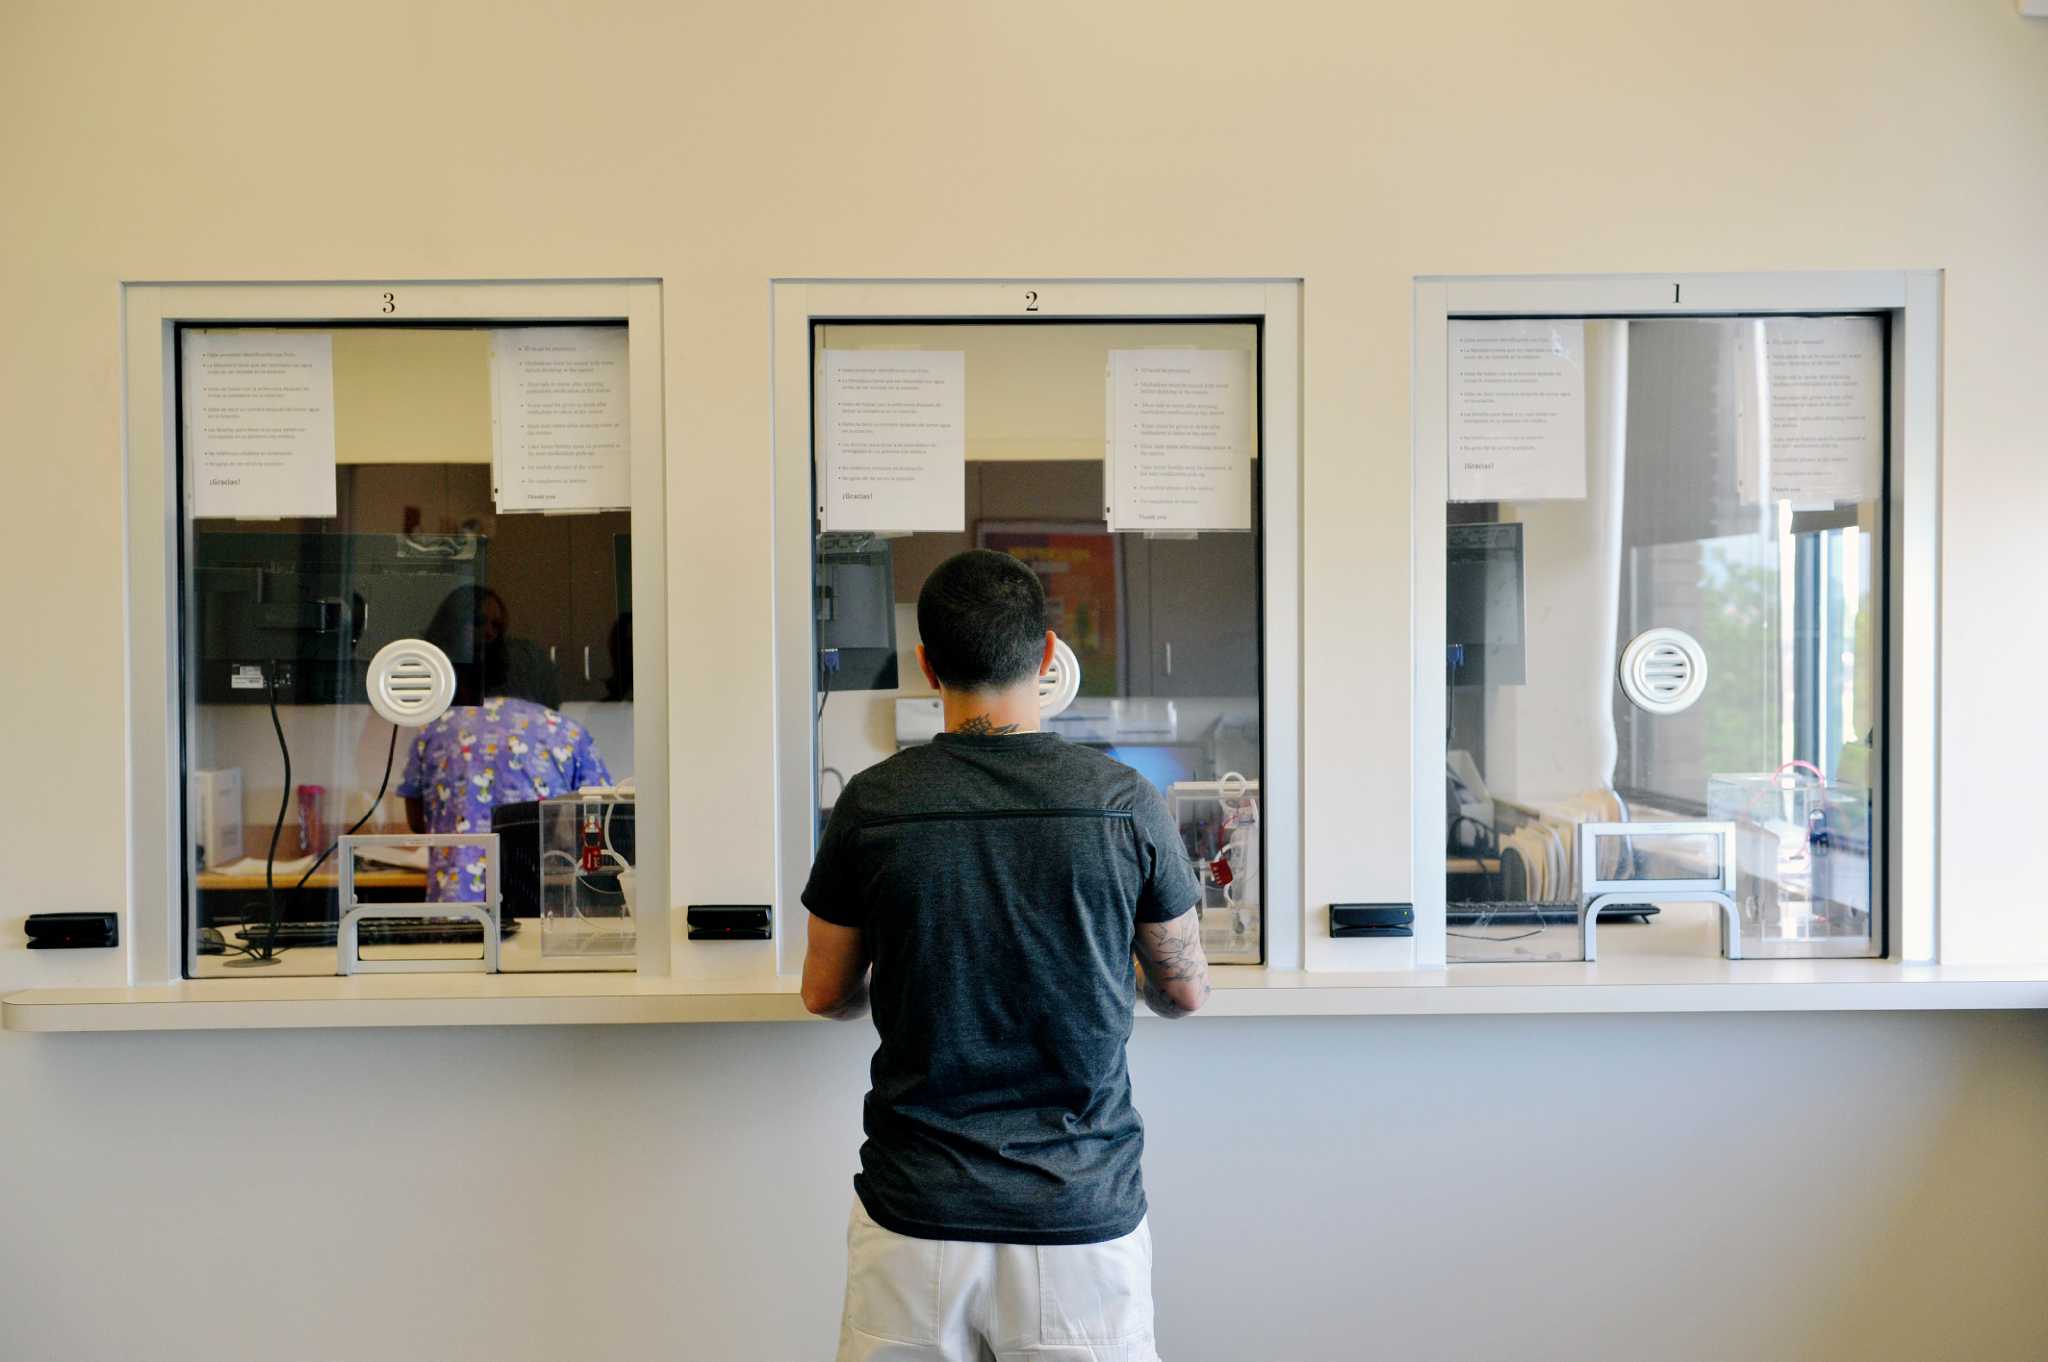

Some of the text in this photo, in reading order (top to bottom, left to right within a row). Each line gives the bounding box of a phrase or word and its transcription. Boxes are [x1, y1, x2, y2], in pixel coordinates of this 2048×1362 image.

[382, 292, 396, 313] 3
[1025, 290, 1039, 312] 2
[1672, 283, 1682, 304] 1
